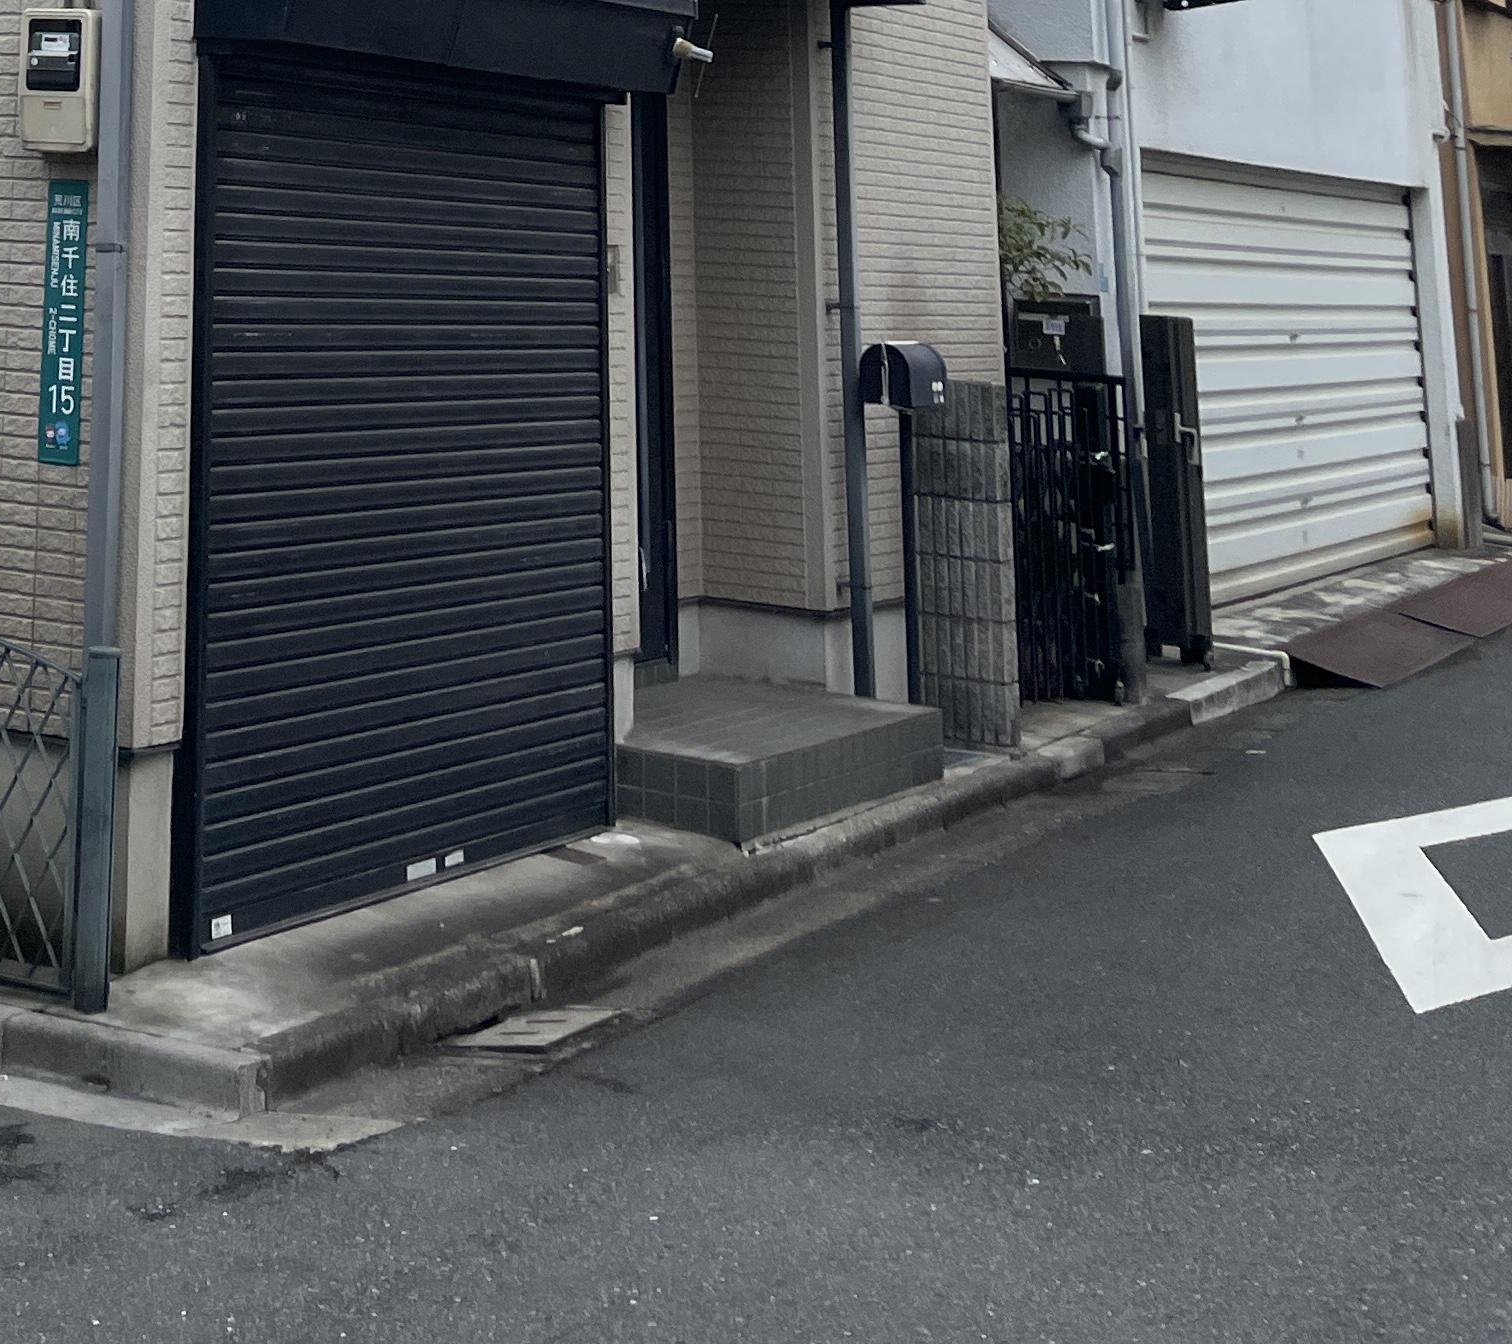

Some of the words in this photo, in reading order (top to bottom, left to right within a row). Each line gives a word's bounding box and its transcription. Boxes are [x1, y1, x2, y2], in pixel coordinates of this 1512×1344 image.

[58, 219, 81, 381] 南千住二丁目
[48, 384, 75, 415] 15
